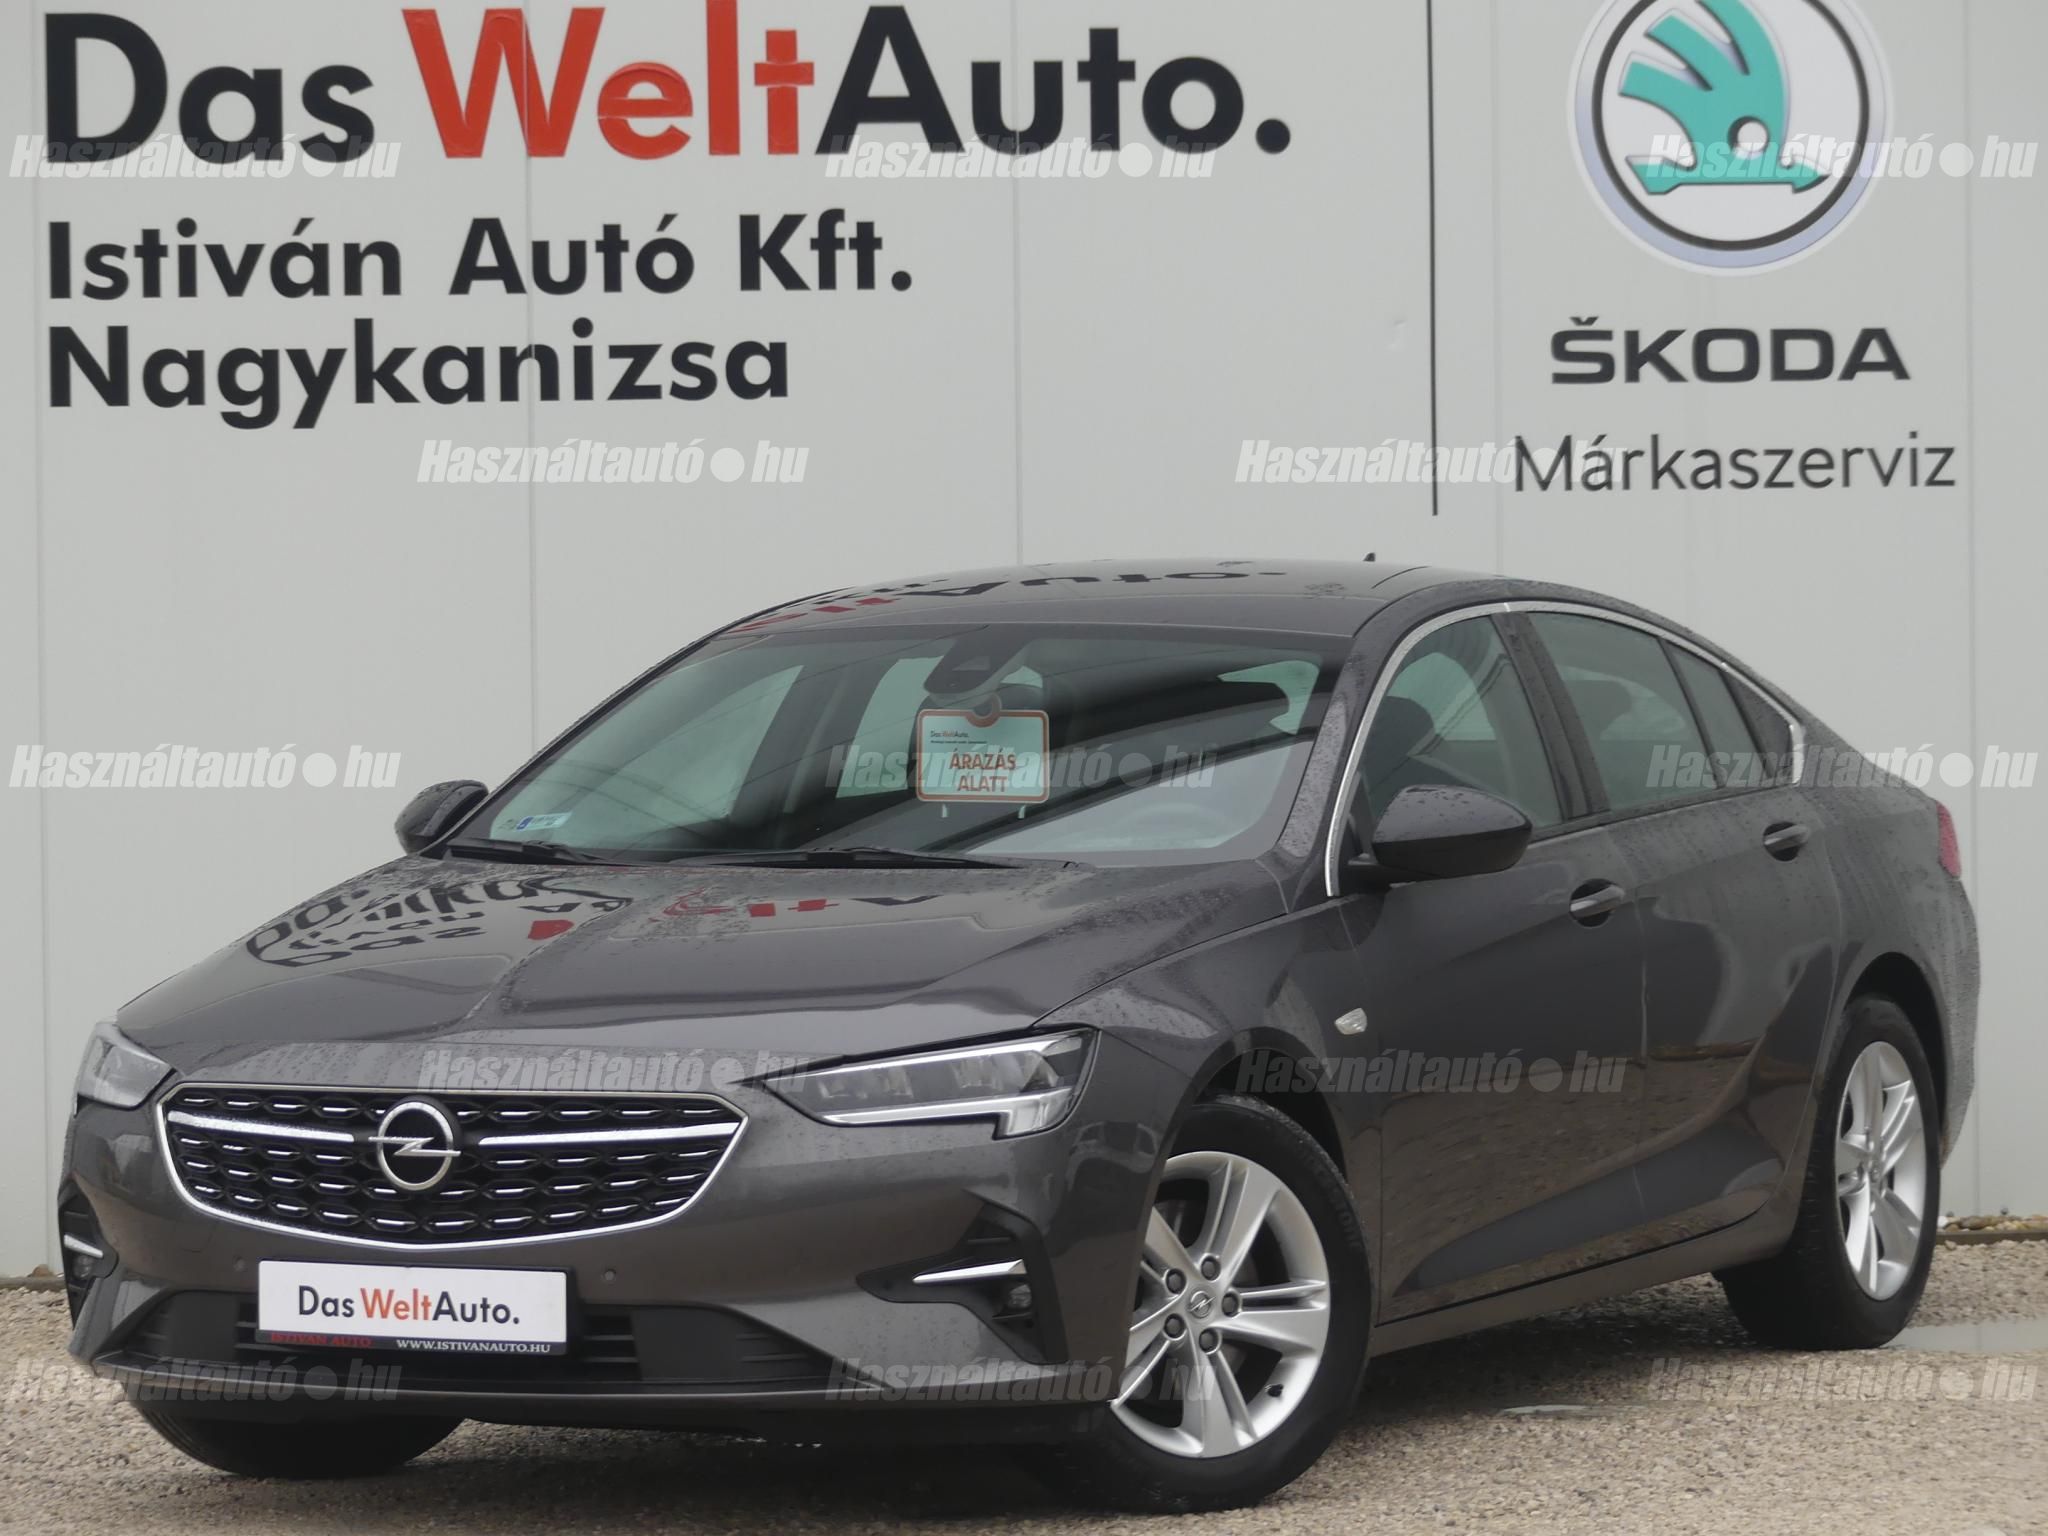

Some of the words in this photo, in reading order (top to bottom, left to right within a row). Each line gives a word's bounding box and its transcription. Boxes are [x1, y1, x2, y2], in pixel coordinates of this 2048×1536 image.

[46, 12, 375, 165] Das
[50, 217, 401, 301] Istiván
[450, 213, 695, 296] Autó
[740, 208, 912, 292] Kft.
[49, 317, 788, 430] Nagykanizsa
[1551, 316, 1911, 385] ŠKODA
[1515, 431, 1955, 492] Márkaszerviz
[949, 748, 1017, 770] ÁRAZÁS
[957, 775, 1009, 792] ALATT
[299, 1285, 354, 1318] Das
[396, 1338, 551, 1353] WWW.ISTIVANAUTO.HU
